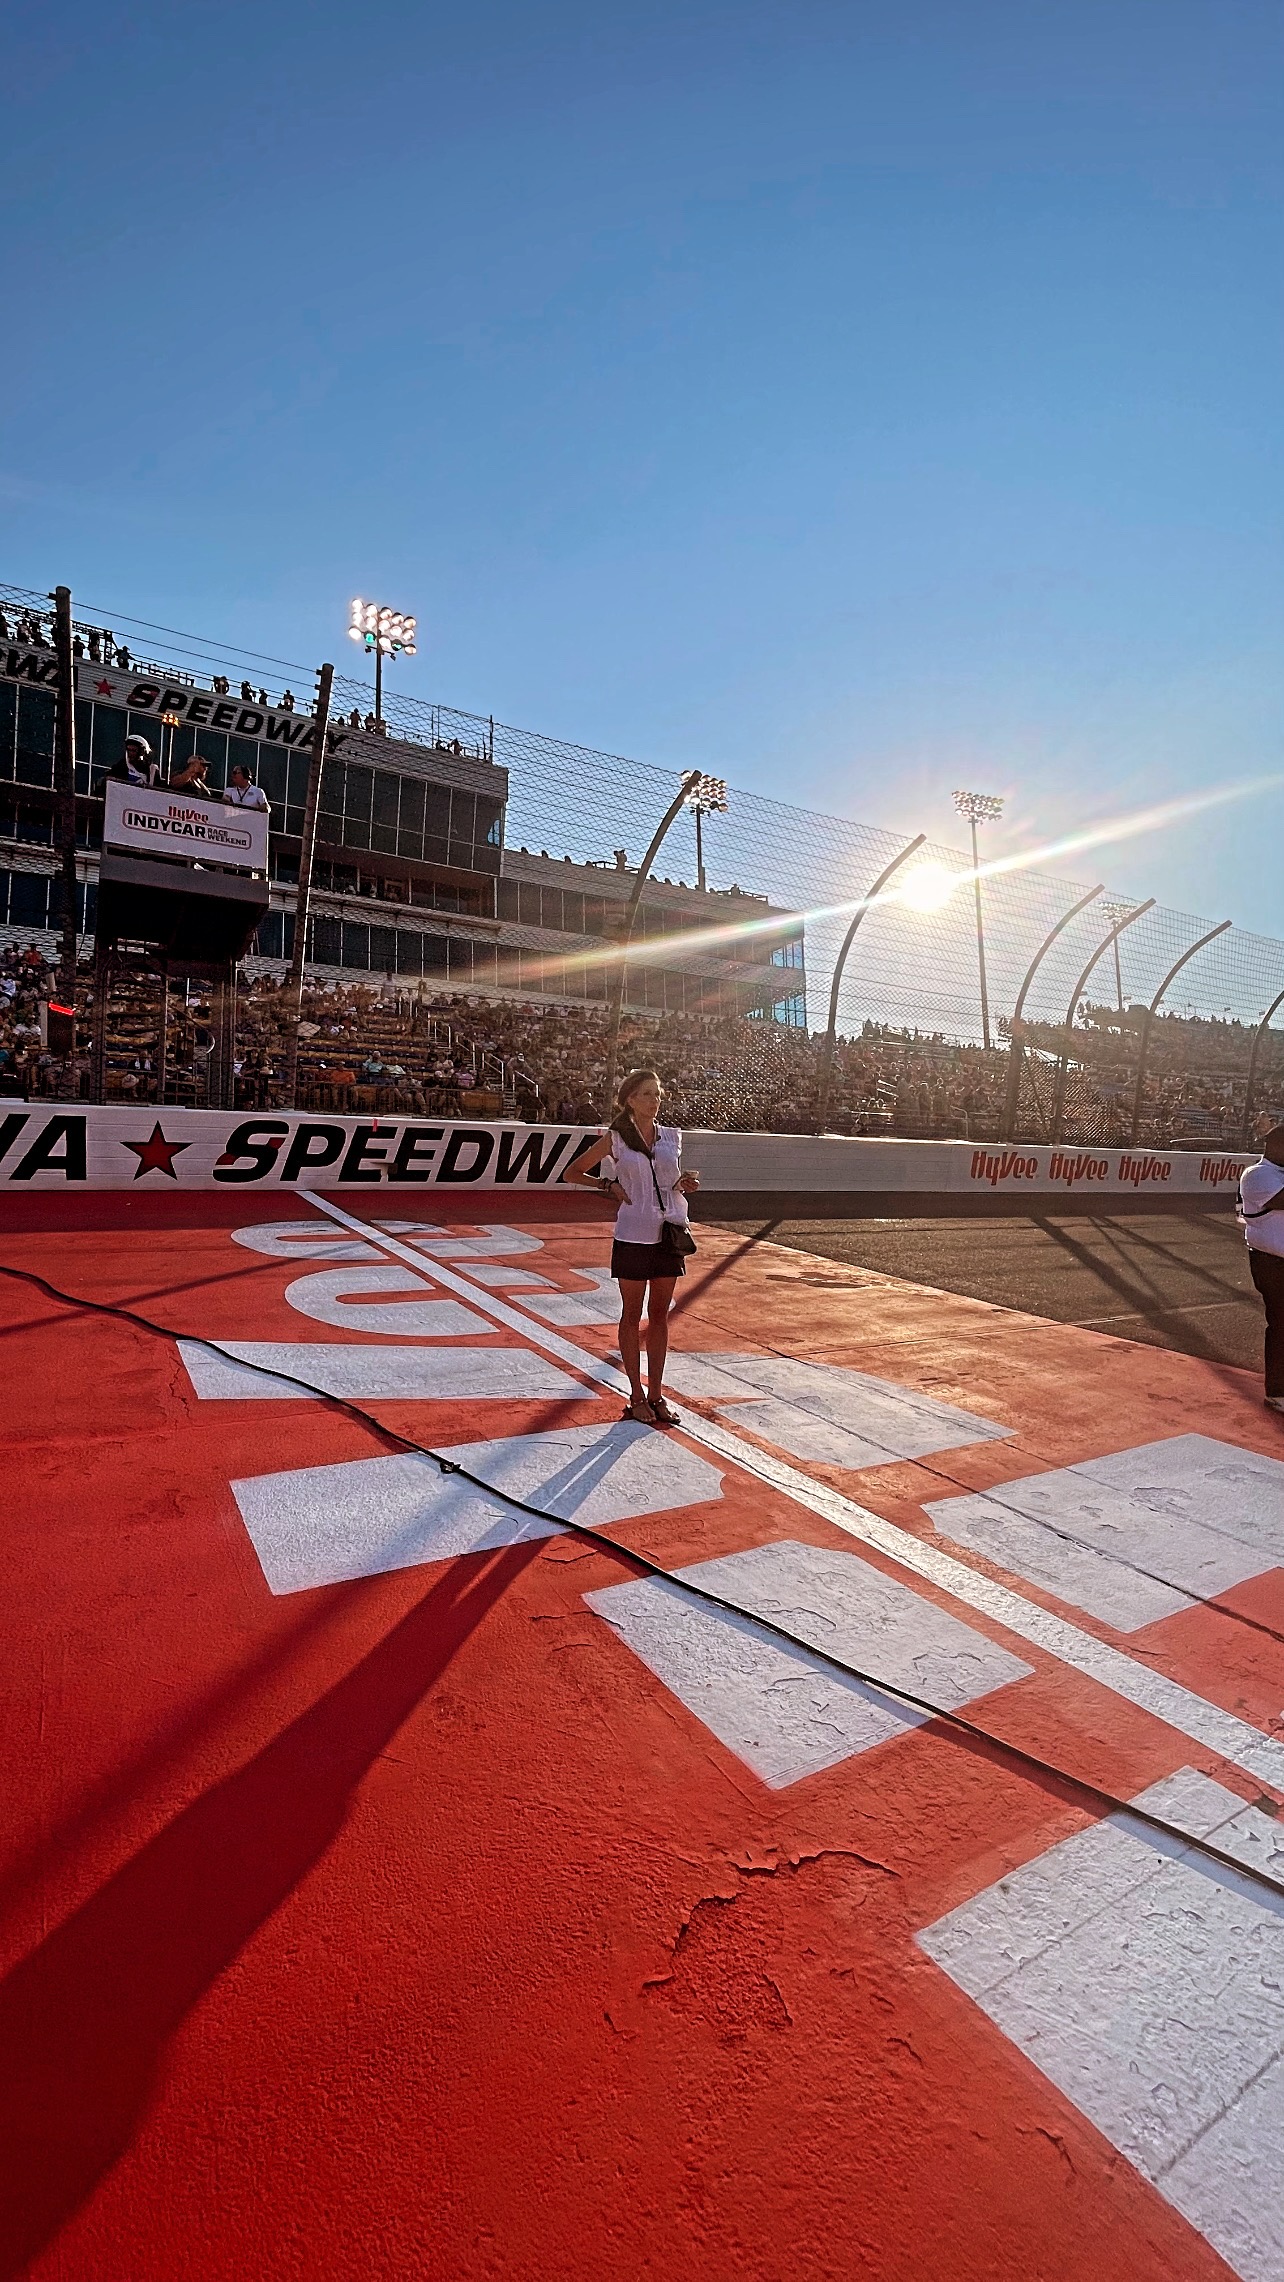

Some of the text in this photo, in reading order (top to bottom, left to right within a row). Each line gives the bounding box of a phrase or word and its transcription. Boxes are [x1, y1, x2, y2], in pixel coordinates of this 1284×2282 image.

[126, 683, 347, 753] SPEEDWAY
[127, 812, 206, 839] INDYCAR
[168, 805, 209, 824] HyVee
[207, 827, 229, 838] RACE
[207, 834, 247, 847] WEEKEND
[970, 1150, 1038, 1187] HyVee
[1049, 1153, 1109, 1187] HyVee
[1118, 1155, 1171, 1187] HyVee
